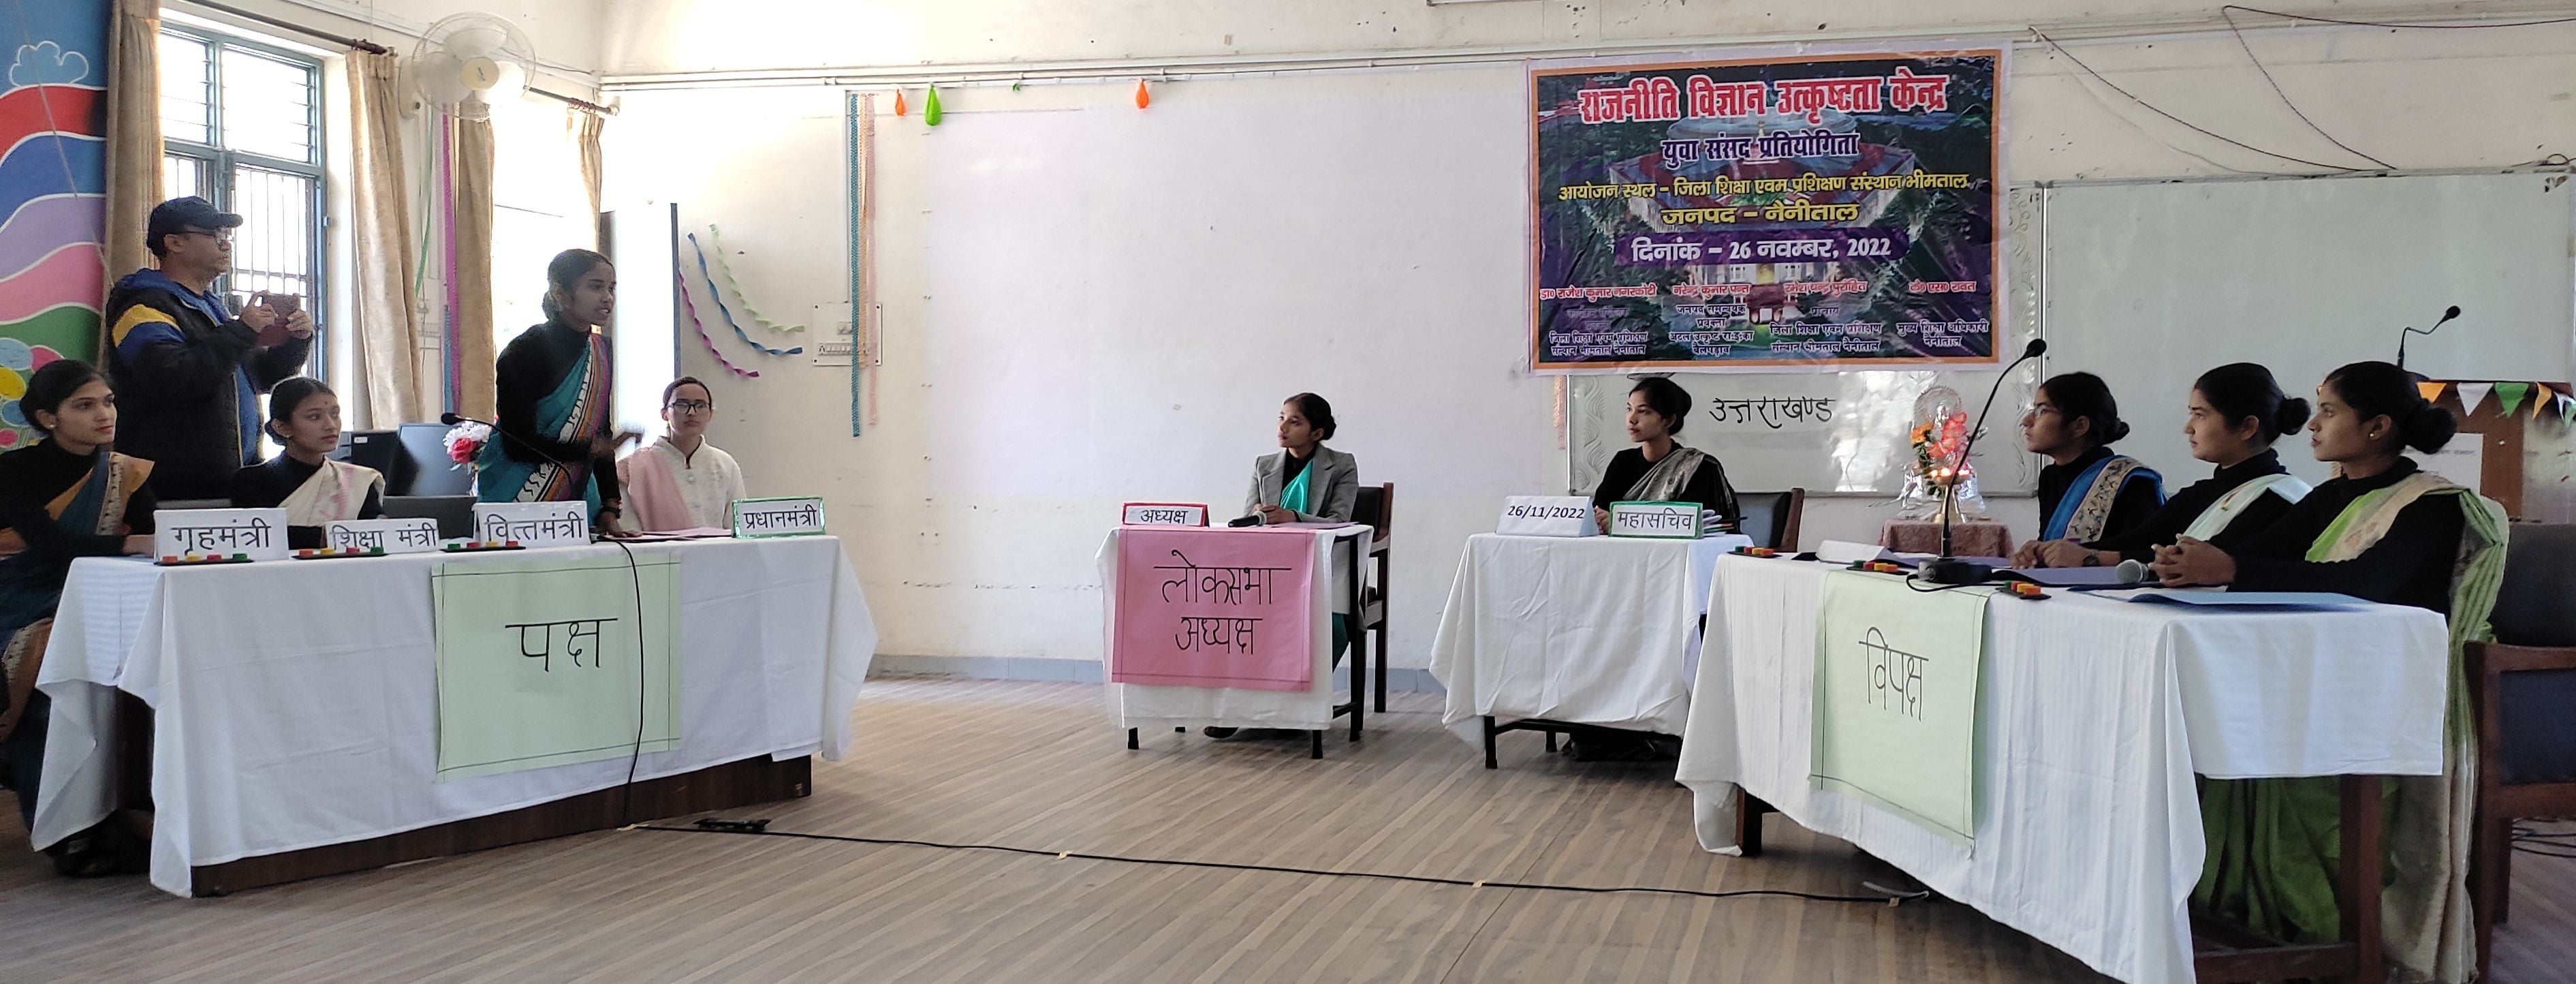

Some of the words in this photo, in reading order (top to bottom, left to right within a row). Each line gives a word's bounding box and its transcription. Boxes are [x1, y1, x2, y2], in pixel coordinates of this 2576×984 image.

[1577, 76, 1681, 125] राजनीति
[1686, 74, 1768, 120] विज्ञान
[1774, 75, 1884, 126] उत्कृष्टता
[1888, 66, 1950, 112] केन्द्र
[1661, 138, 1700, 170] युवा
[1705, 132, 1754, 161] संसद
[1757, 128, 1860, 159] प्रतियोगिता
[1558, 179, 1619, 202] आयोजन
[1621, 182, 1657, 200] स्थल
[1673, 176, 1712, 197] जिला
[1715, 174, 1751, 196] शिक्षा
[1753, 178, 1789, 195] एवम
[1791, 172, 1847, 195] प्रशिक्षण
[1849, 170, 1902, 193] संस्थान
[1905, 168, 1970, 190] भीमताल
[1661, 207, 1738, 226] जनपद
[1764, 199, 1860, 223] नैनीताल
[1631, 236, 1703, 262] दिनांक
[1729, 241, 1751, 260] 26
[1757, 239, 1839, 259] नवम्बर,
[1846, 239, 1891, 257] 2022
[1556, 285, 1584, 298] राजेश
[1585, 287, 1612, 303] कुमार
[1672, 281, 1699, 297] नरेन्द्र
[1700, 284, 1729, 301] कुमार
[1729, 283, 1751, 295] पन्त
[1784, 281, 1809, 294] रमेश
[1809, 281, 1831, 295] चन्द्र
[1831, 278, 1868, 296] पुरोहित
[1950, 281, 1977, 293] रावत
[1676, 305, 1706, 316] जनपद
[1549, 330, 1571, 344] जिला
[1571, 330, 1595, 344] शिक्षा
[1669, 330, 1692, 343] अटल
[1769, 322, 1793, 335] जिला
[1795, 321, 1821, 335] शिक्षा
[1896, 322, 1919, 337] मुख्य
[1919, 319, 1947, 334] शिक्षा
[1947, 318, 1990, 333] अधिकारी
[1804, 337, 1841, 353] भीमताल
[1842, 337, 1882, 352] नैनीताल
[1709, 397, 1836, 429] उत्तराखण्ड
[484, 510, 584, 540] वित्तमंत्री
[743, 504, 818, 529] प्रधानमंत्री
[1140, 509, 1189, 525] अध्यक्ष
[1507, 504, 1586, 521] 26/11/2022
[1617, 508, 1695, 532] महासचिव
[171, 518, 272, 552] गृहमंत्री
[329, 524, 385, 551] शिक्षा
[396, 522, 439, 547] मंत्री
[1153, 549, 1292, 606] लोकसभा
[505, 617, 618, 673] पक्ष
[1175, 616, 1263, 655] अध्यक्ष
[1858, 627, 1929, 722] विपक्ष
